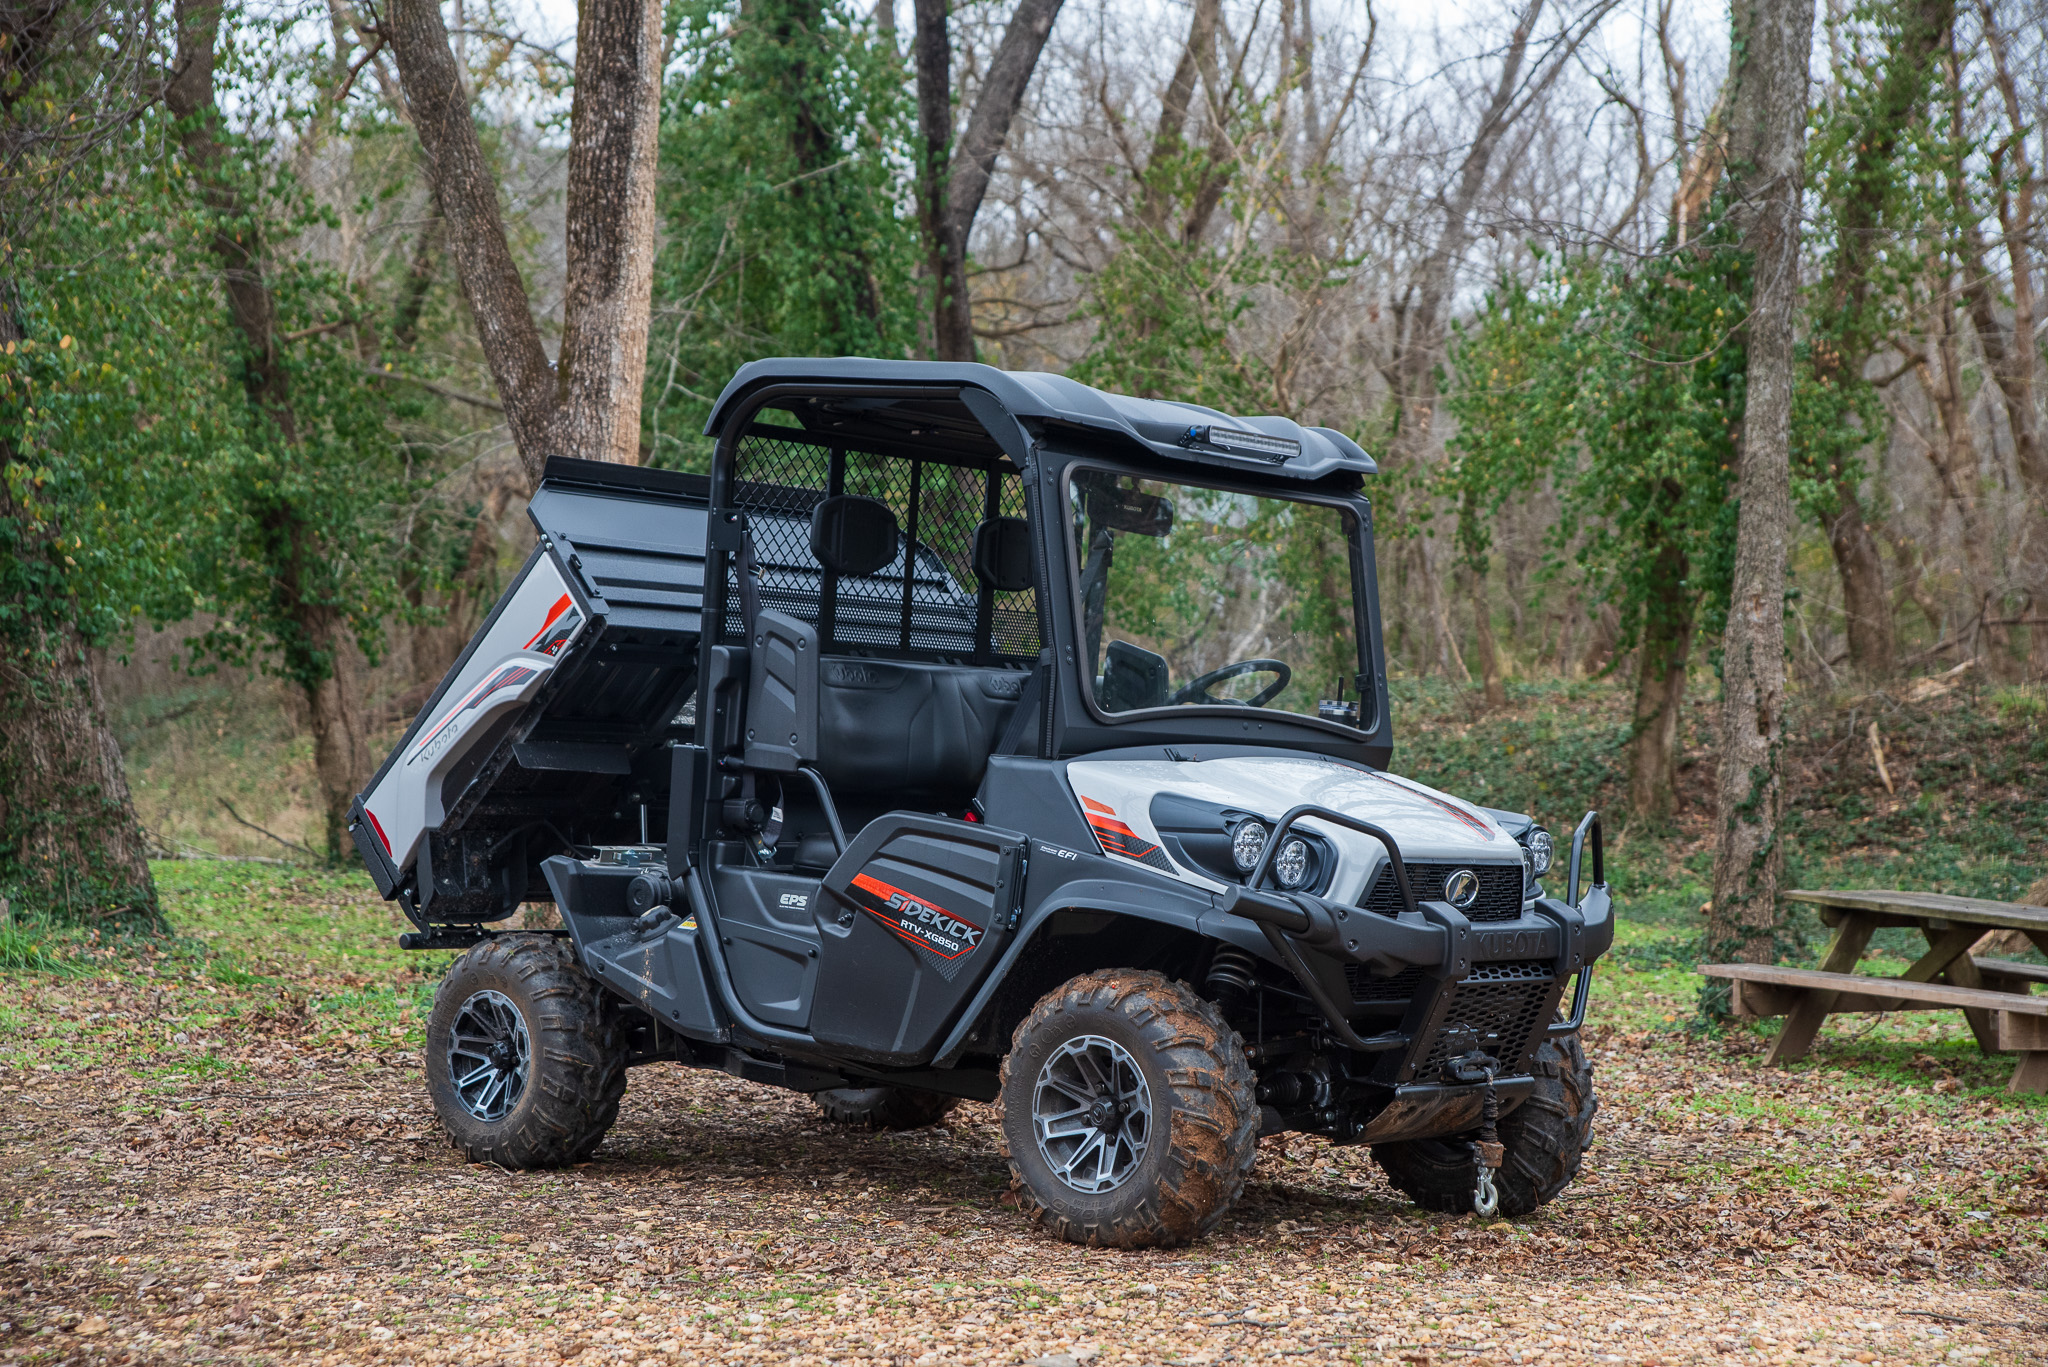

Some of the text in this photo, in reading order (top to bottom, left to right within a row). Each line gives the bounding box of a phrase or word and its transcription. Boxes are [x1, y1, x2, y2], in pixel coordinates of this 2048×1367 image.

[988, 675, 1024, 696] Kubot
[420, 724, 458, 762] Kubota
[1057, 849, 1078, 861] EFI
[779, 893, 808, 907] EPS
[884, 892, 982, 946] SIDEKICK
[901, 919, 959, 952] RTV-XG850
[1475, 930, 1549, 961] KUBOTA
